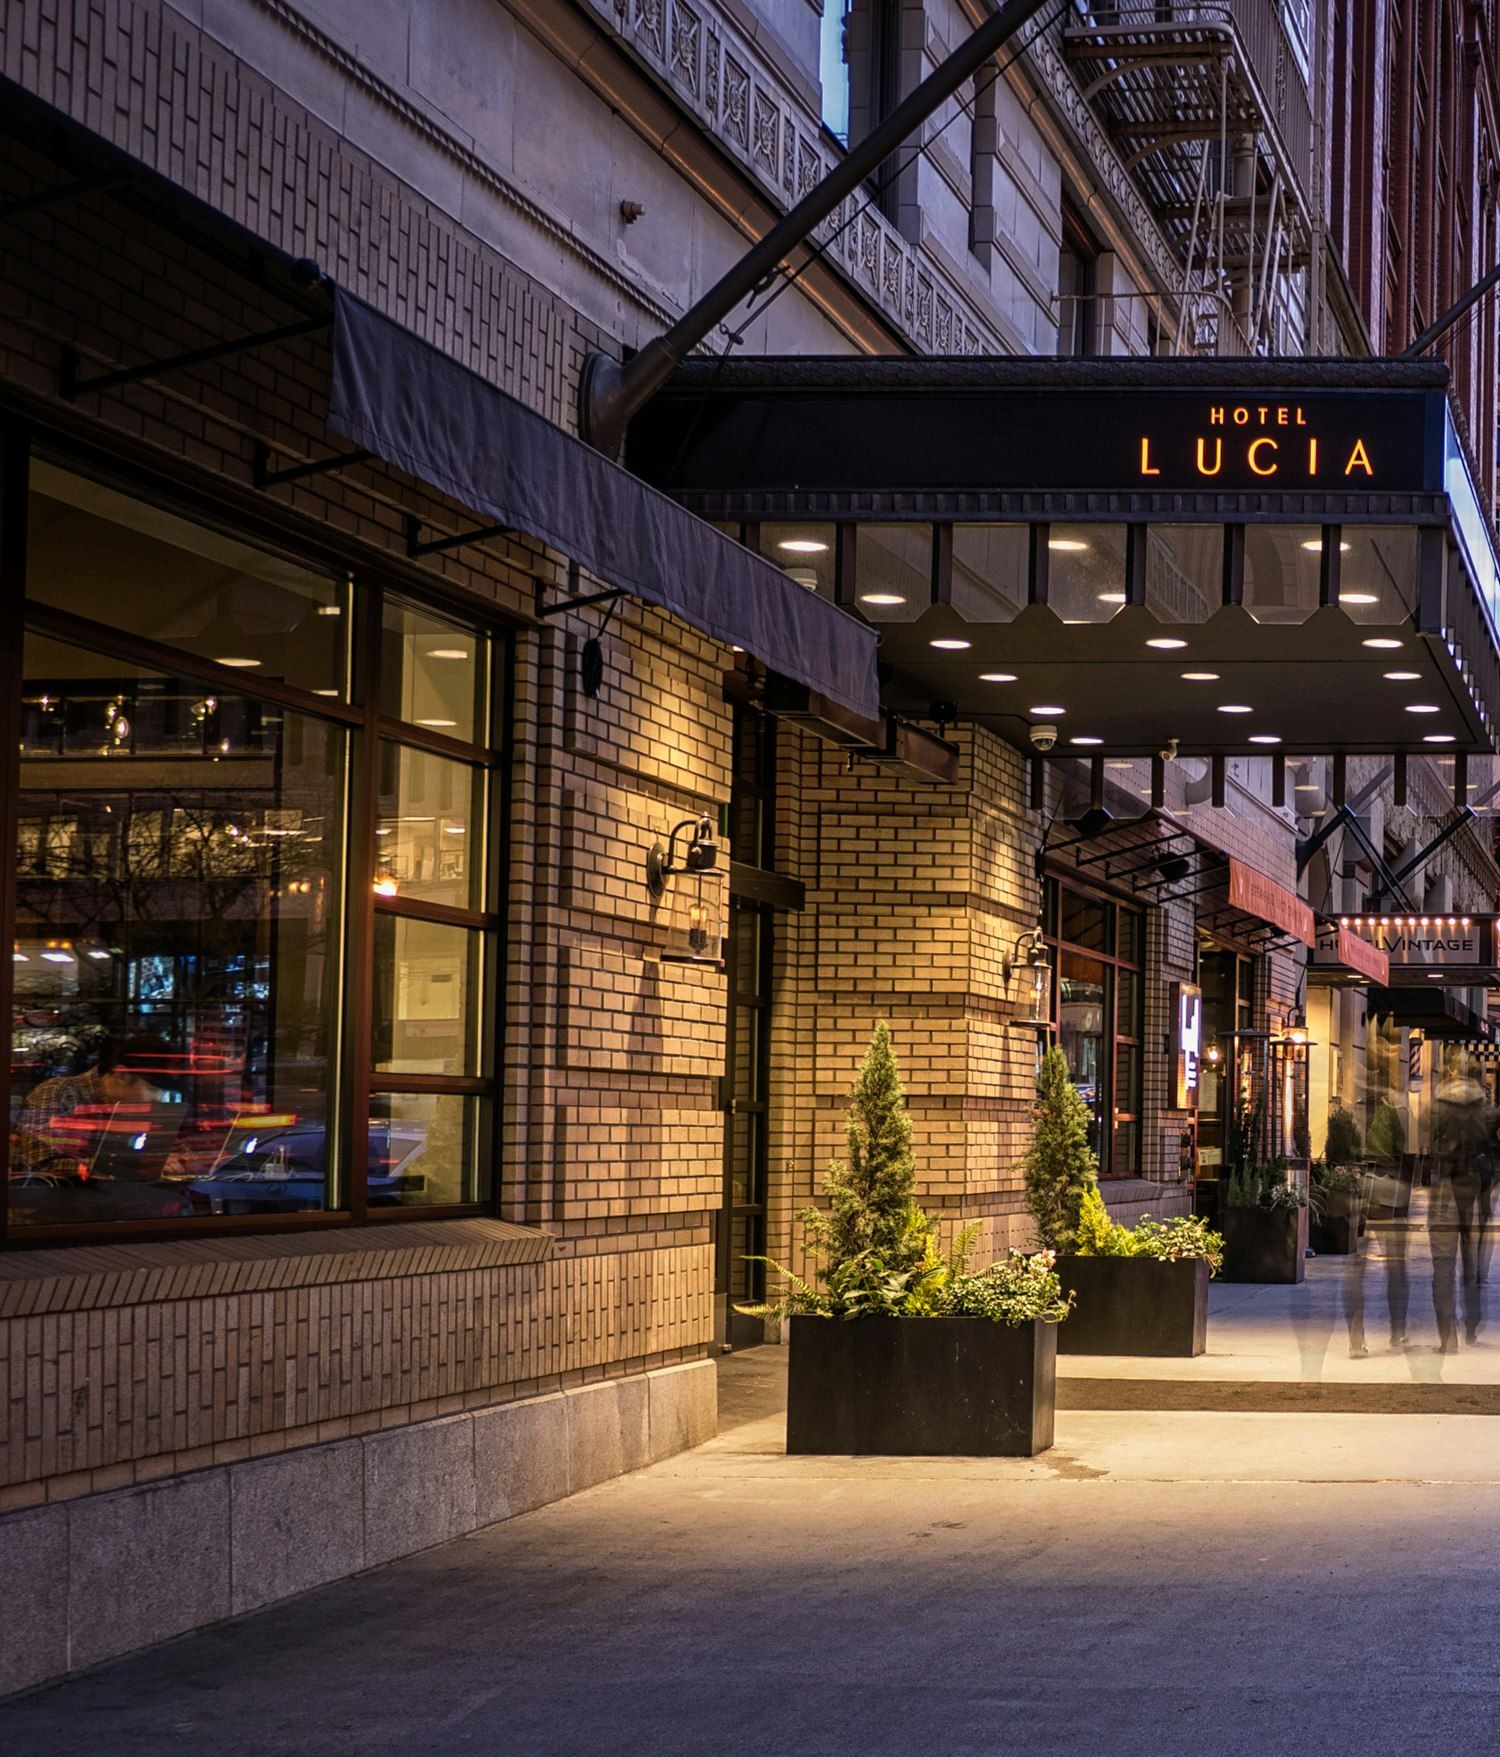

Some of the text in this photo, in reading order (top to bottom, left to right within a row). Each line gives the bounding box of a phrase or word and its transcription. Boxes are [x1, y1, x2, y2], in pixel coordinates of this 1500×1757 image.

[1210, 407, 1306, 425] HOTEL
[1141, 437, 1374, 475] LUCIA
[1383, 936, 1474, 953] VINTAGE
